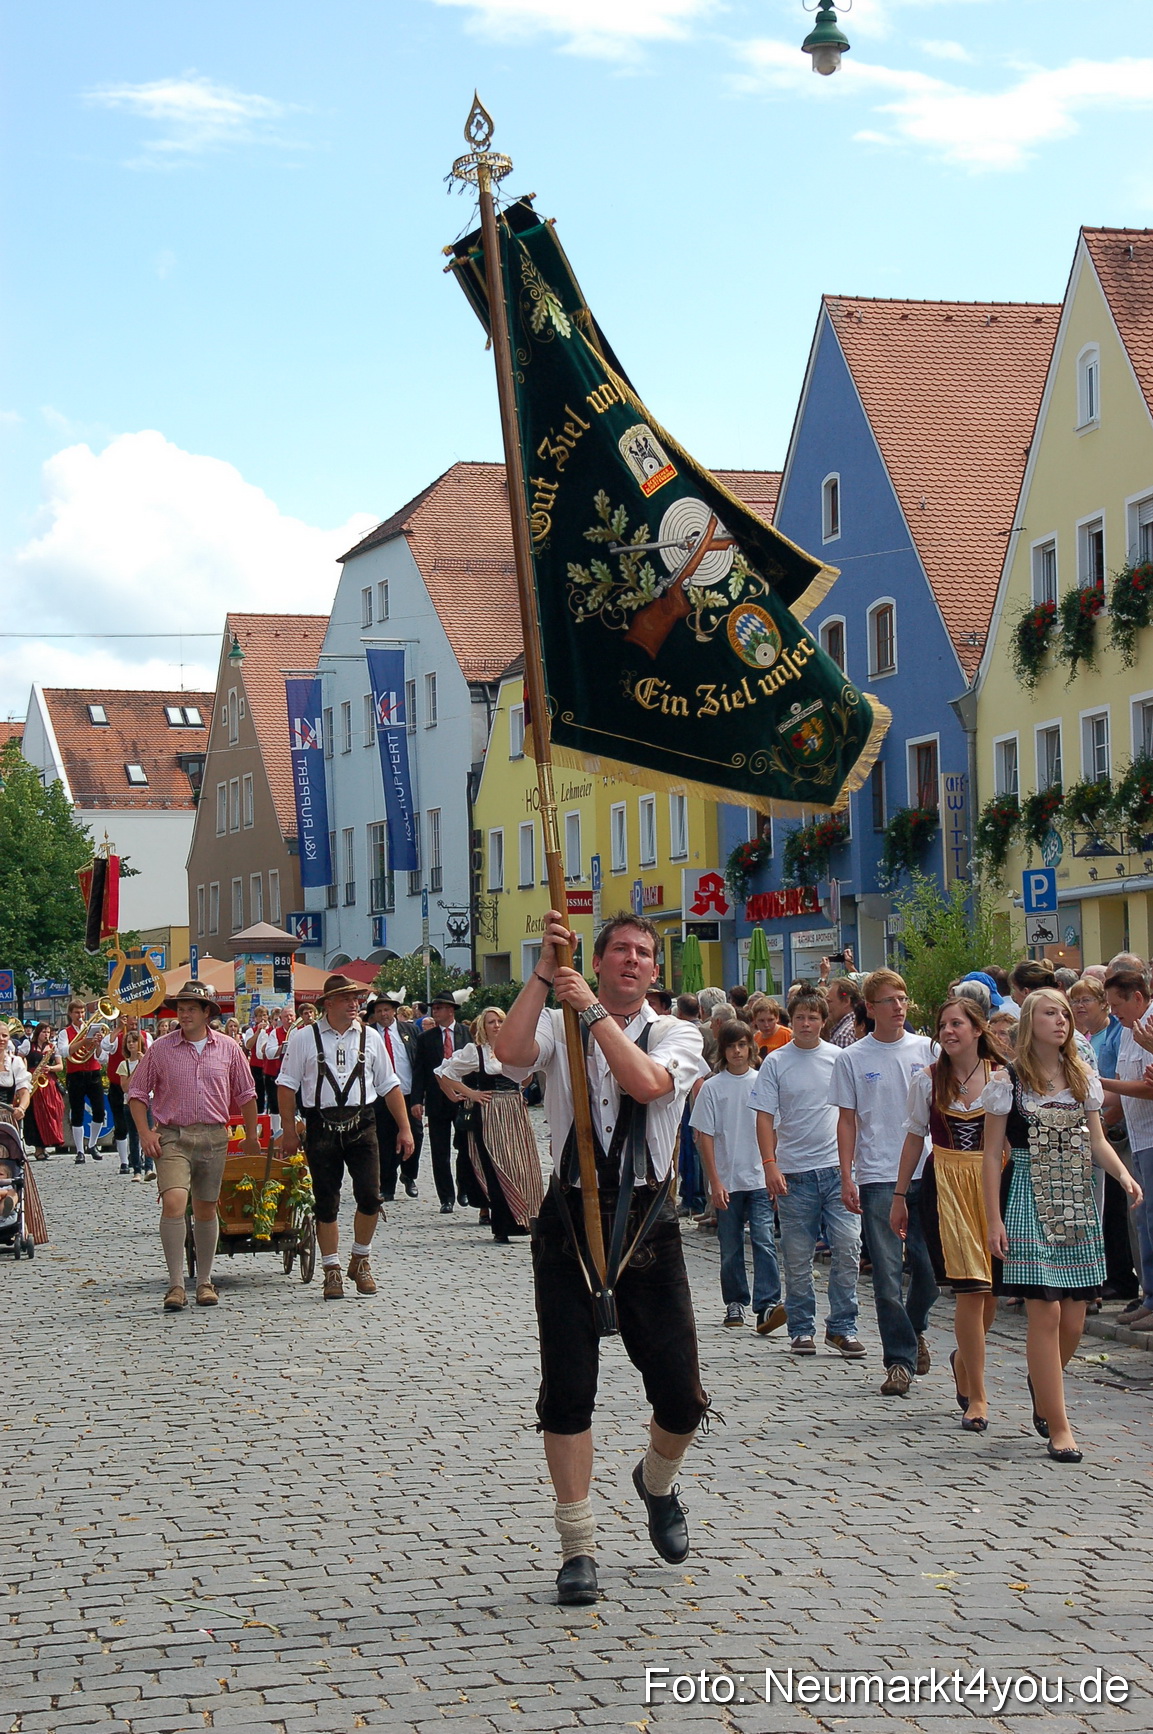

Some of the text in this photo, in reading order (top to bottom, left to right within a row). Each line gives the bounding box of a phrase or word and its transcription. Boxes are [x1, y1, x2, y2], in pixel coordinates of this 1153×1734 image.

[634, 677, 689, 716] Ein
[1030, 874, 1049, 908] P
[566, 898, 593, 908] ISSMAC
[0, 991, 12, 999] AXI
